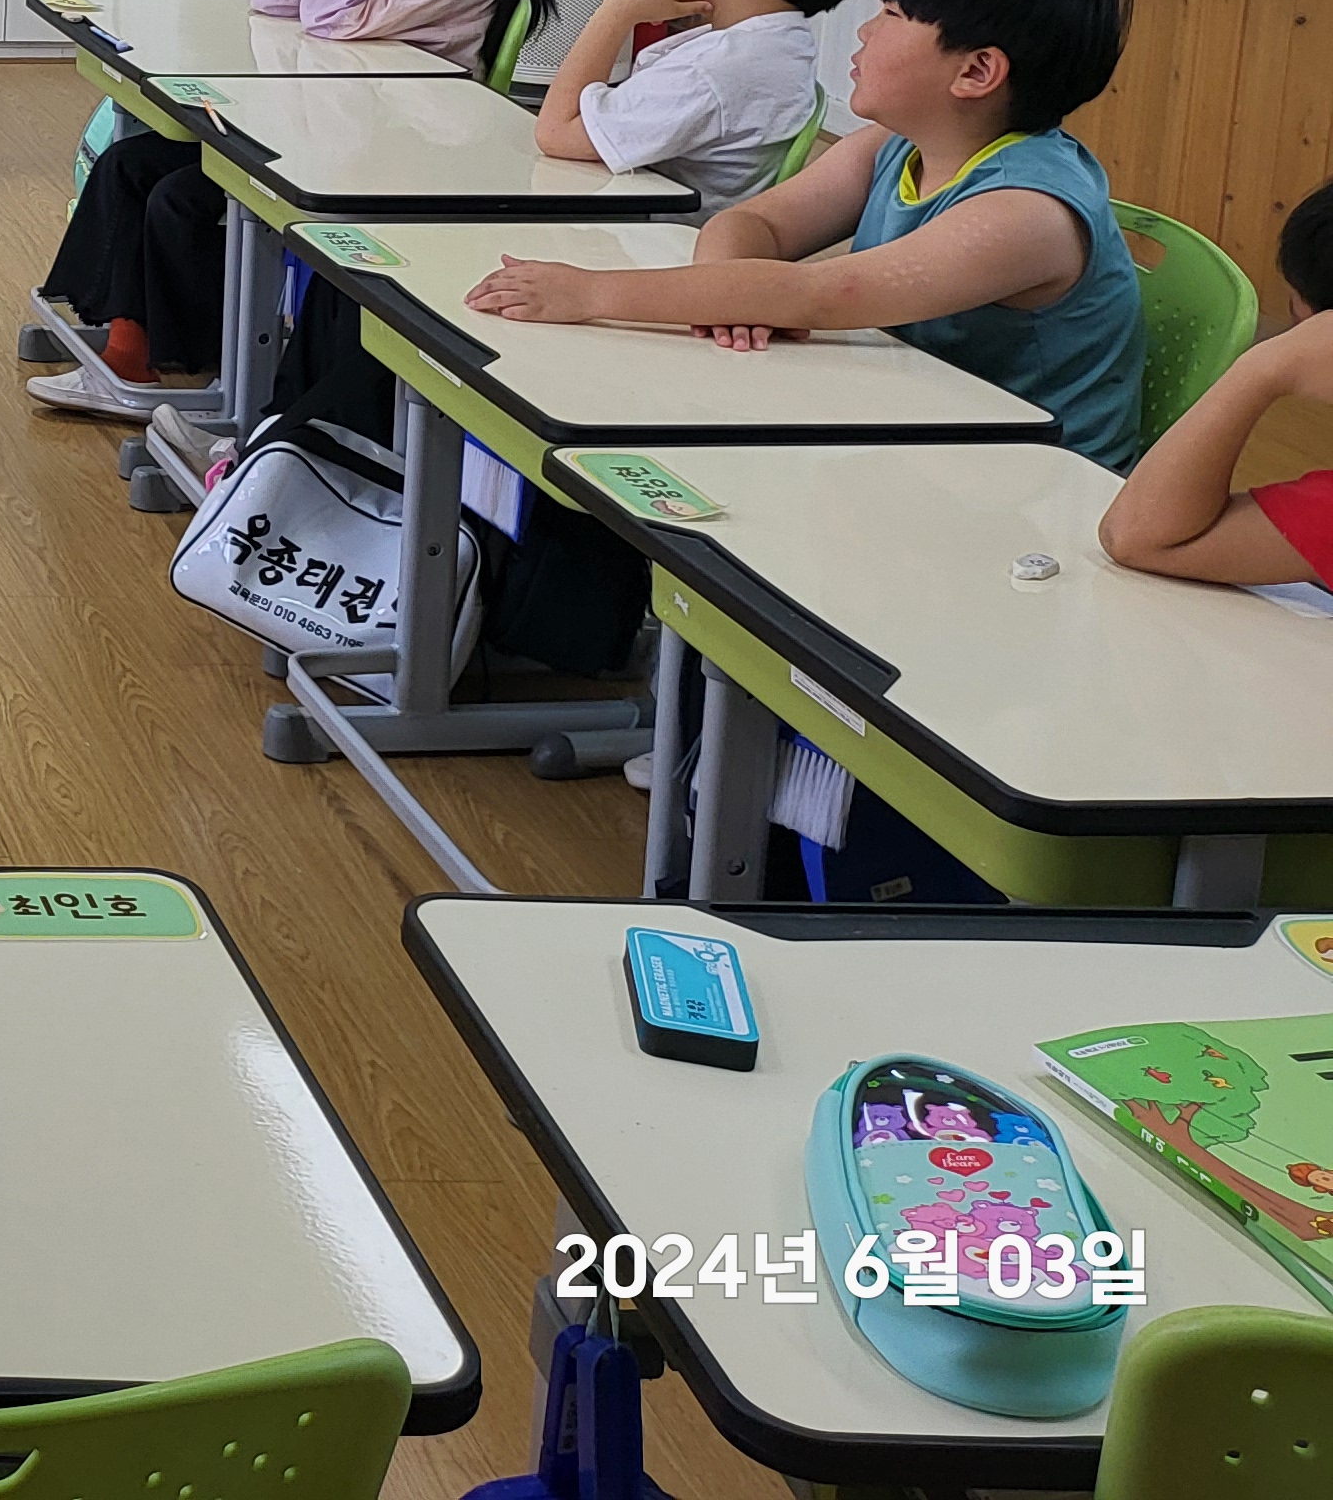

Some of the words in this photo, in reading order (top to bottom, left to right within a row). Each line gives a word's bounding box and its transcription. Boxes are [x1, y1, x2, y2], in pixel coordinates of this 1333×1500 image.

[228, 580, 272, 612] 교육문의
[273, 605, 297, 622] 010
[298, 618, 332, 639] 4663
[7, 893, 147, 919] 최인호
[942, 1158, 981, 1167] Bears
[947, 1152, 975, 1161] Care
